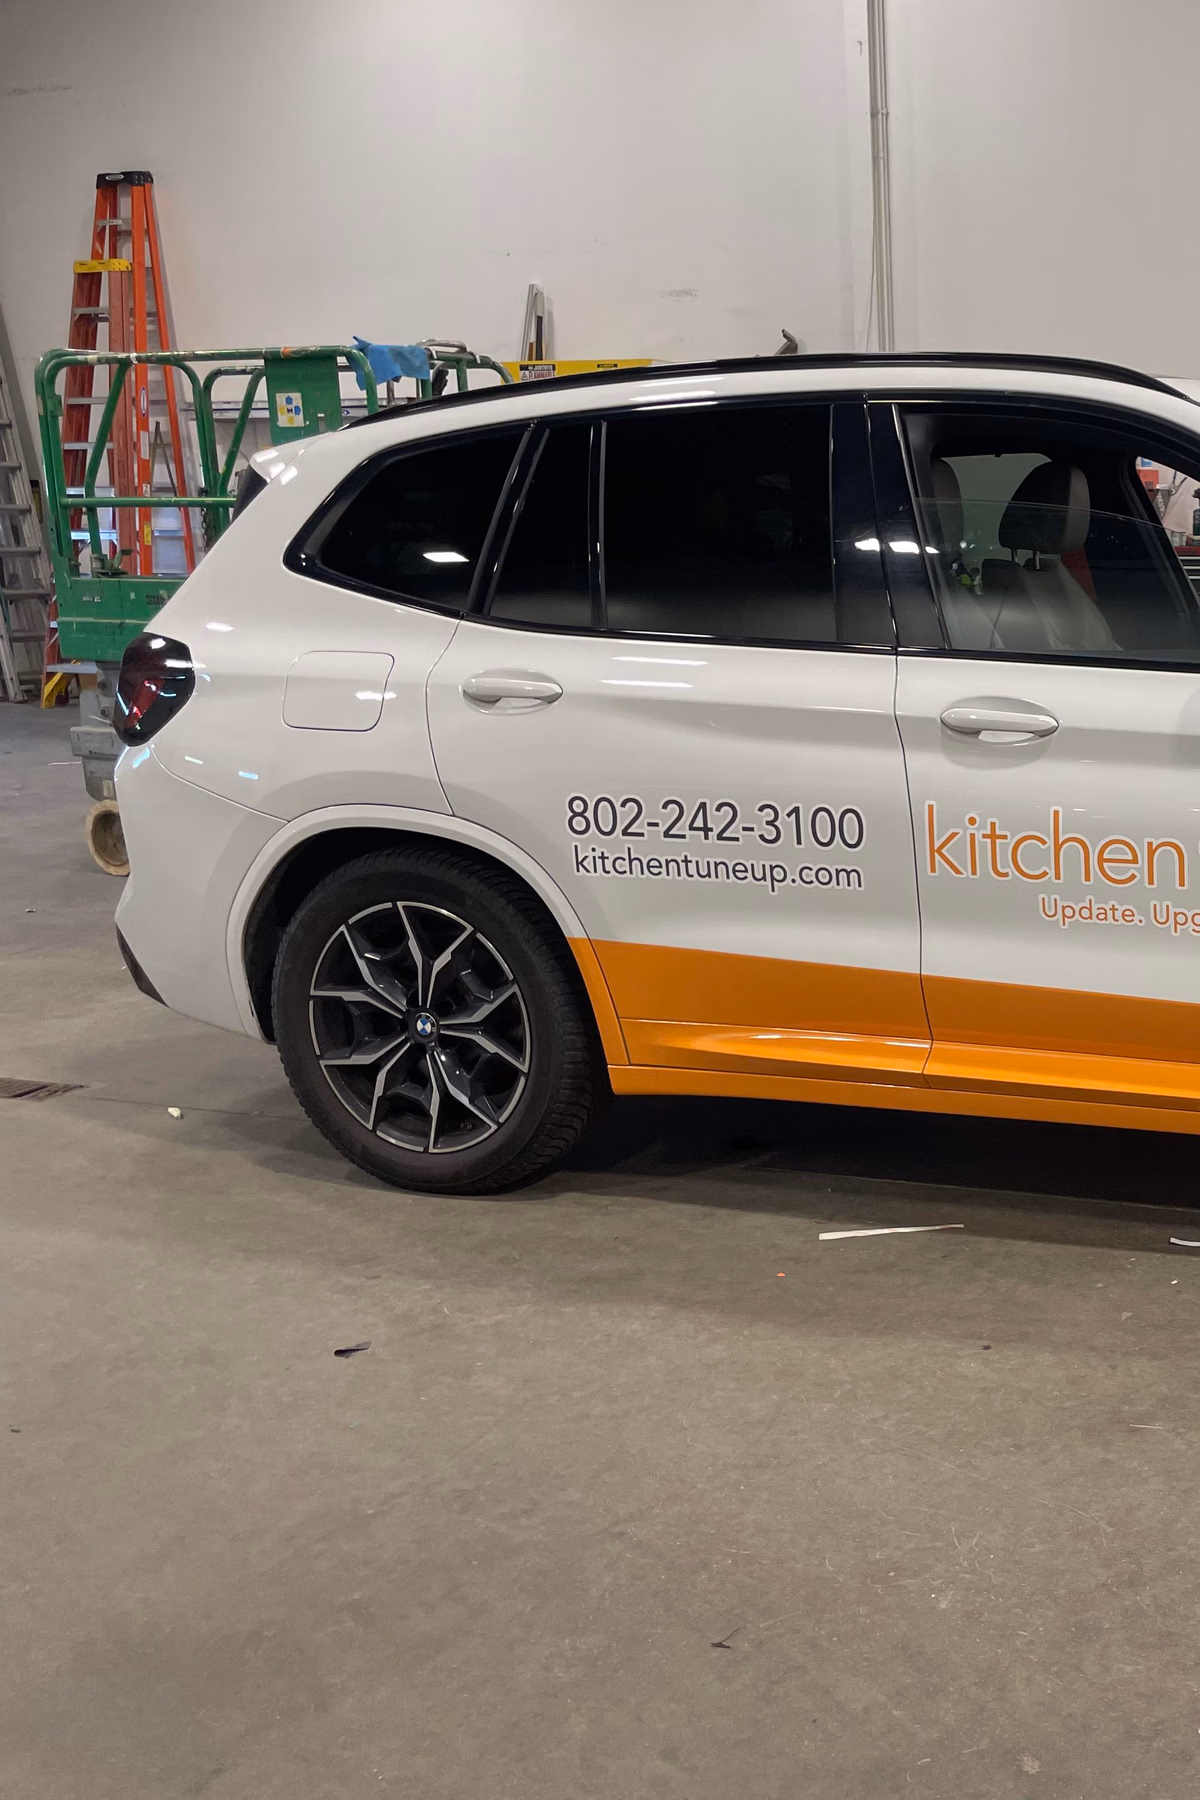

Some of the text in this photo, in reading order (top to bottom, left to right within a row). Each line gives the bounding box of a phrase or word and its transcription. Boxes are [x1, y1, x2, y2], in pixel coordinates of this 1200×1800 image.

[566, 794, 865, 850] 802-242-3100
[926, 802, 1187, 889] kitchen
[573, 844, 862, 893] kitchentuneup.com
[1040, 896, 1143, 926] Update.
